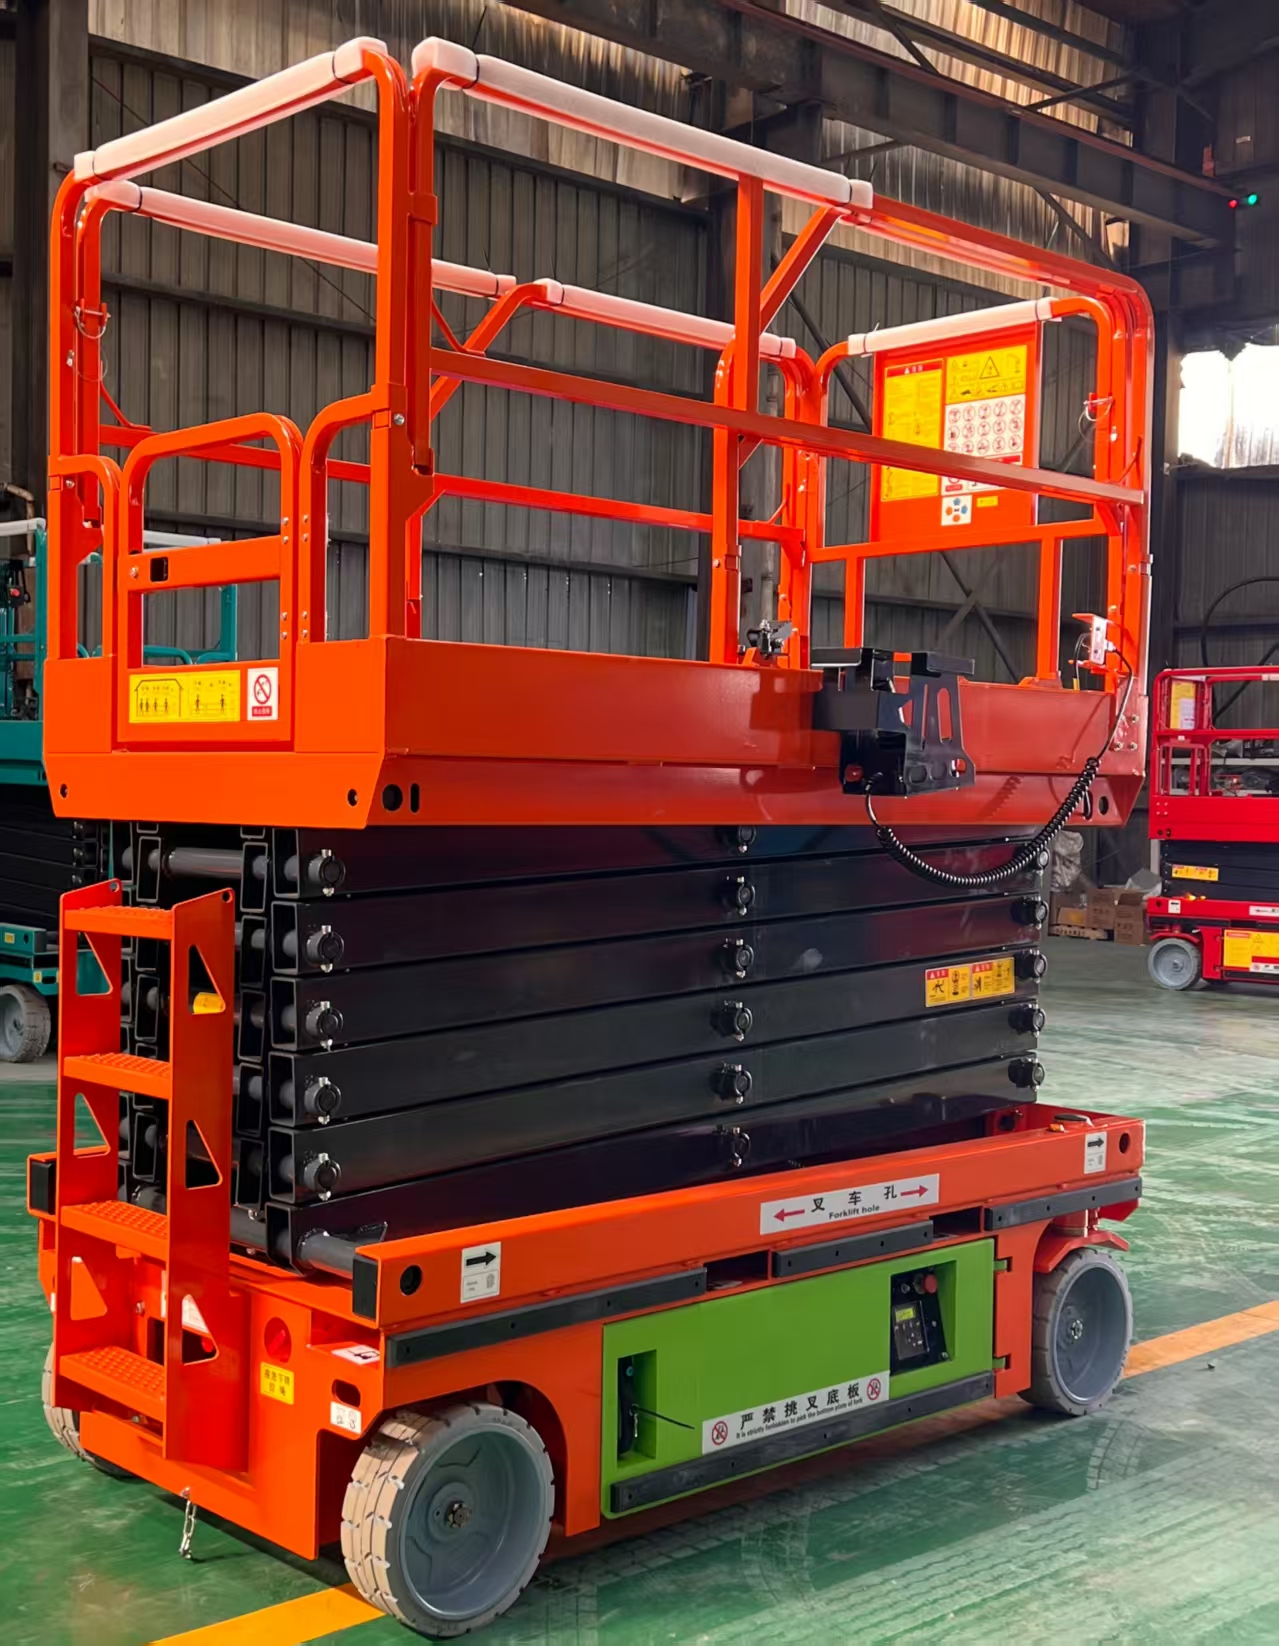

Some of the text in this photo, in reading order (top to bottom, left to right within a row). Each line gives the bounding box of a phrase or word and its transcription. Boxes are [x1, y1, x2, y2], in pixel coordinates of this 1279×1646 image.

[811, 1184, 898, 1213] 叉车孔
[828, 1204, 880, 1220] Forklift hole
[740, 1383, 860, 1430] 严禁挑叉底板
